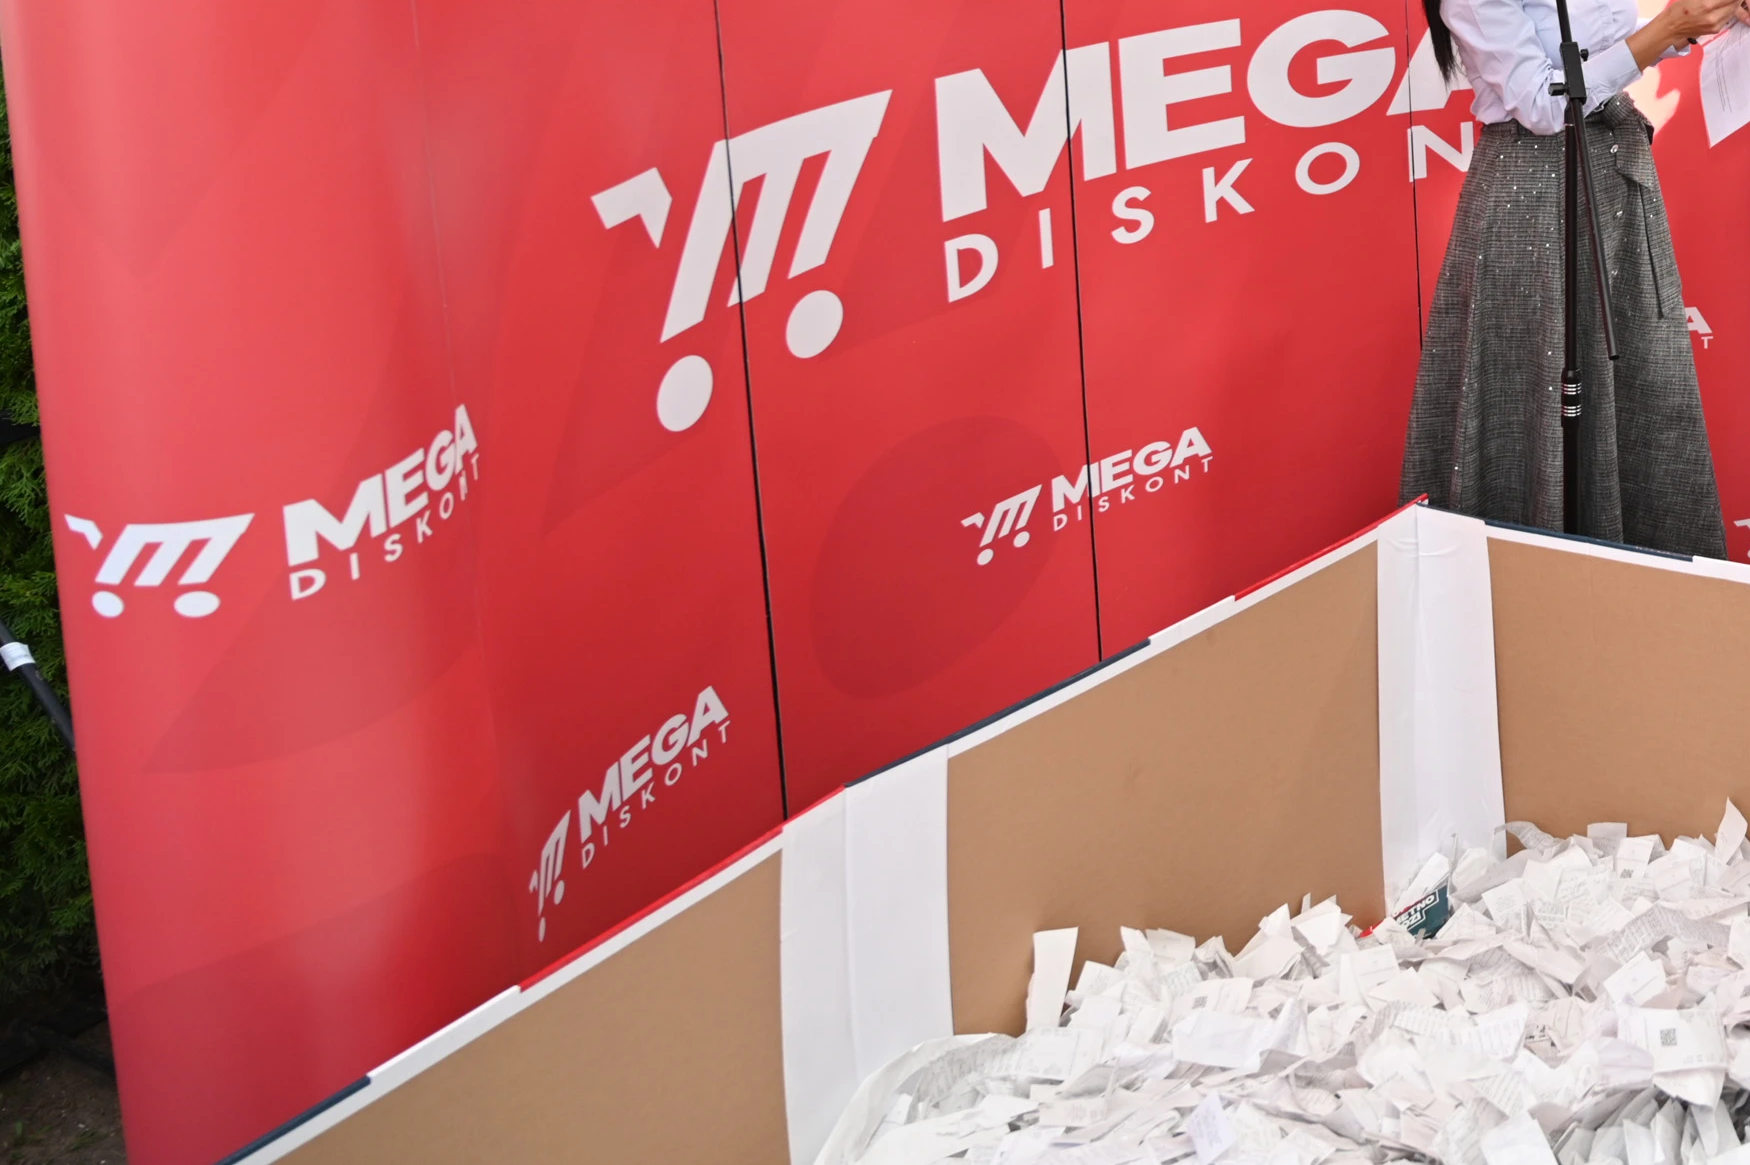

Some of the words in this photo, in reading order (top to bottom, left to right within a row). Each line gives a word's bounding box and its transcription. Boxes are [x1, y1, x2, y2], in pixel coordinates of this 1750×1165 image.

[944, 121, 1475, 303] DISKON
[283, 404, 478, 567] MEGA
[289, 454, 479, 600] DISKONT
[1051, 426, 1212, 513] MEGA
[1053, 456, 1213, 531] DISKONT
[578, 685, 730, 843] MEGA
[582, 720, 731, 868] DISKONT
